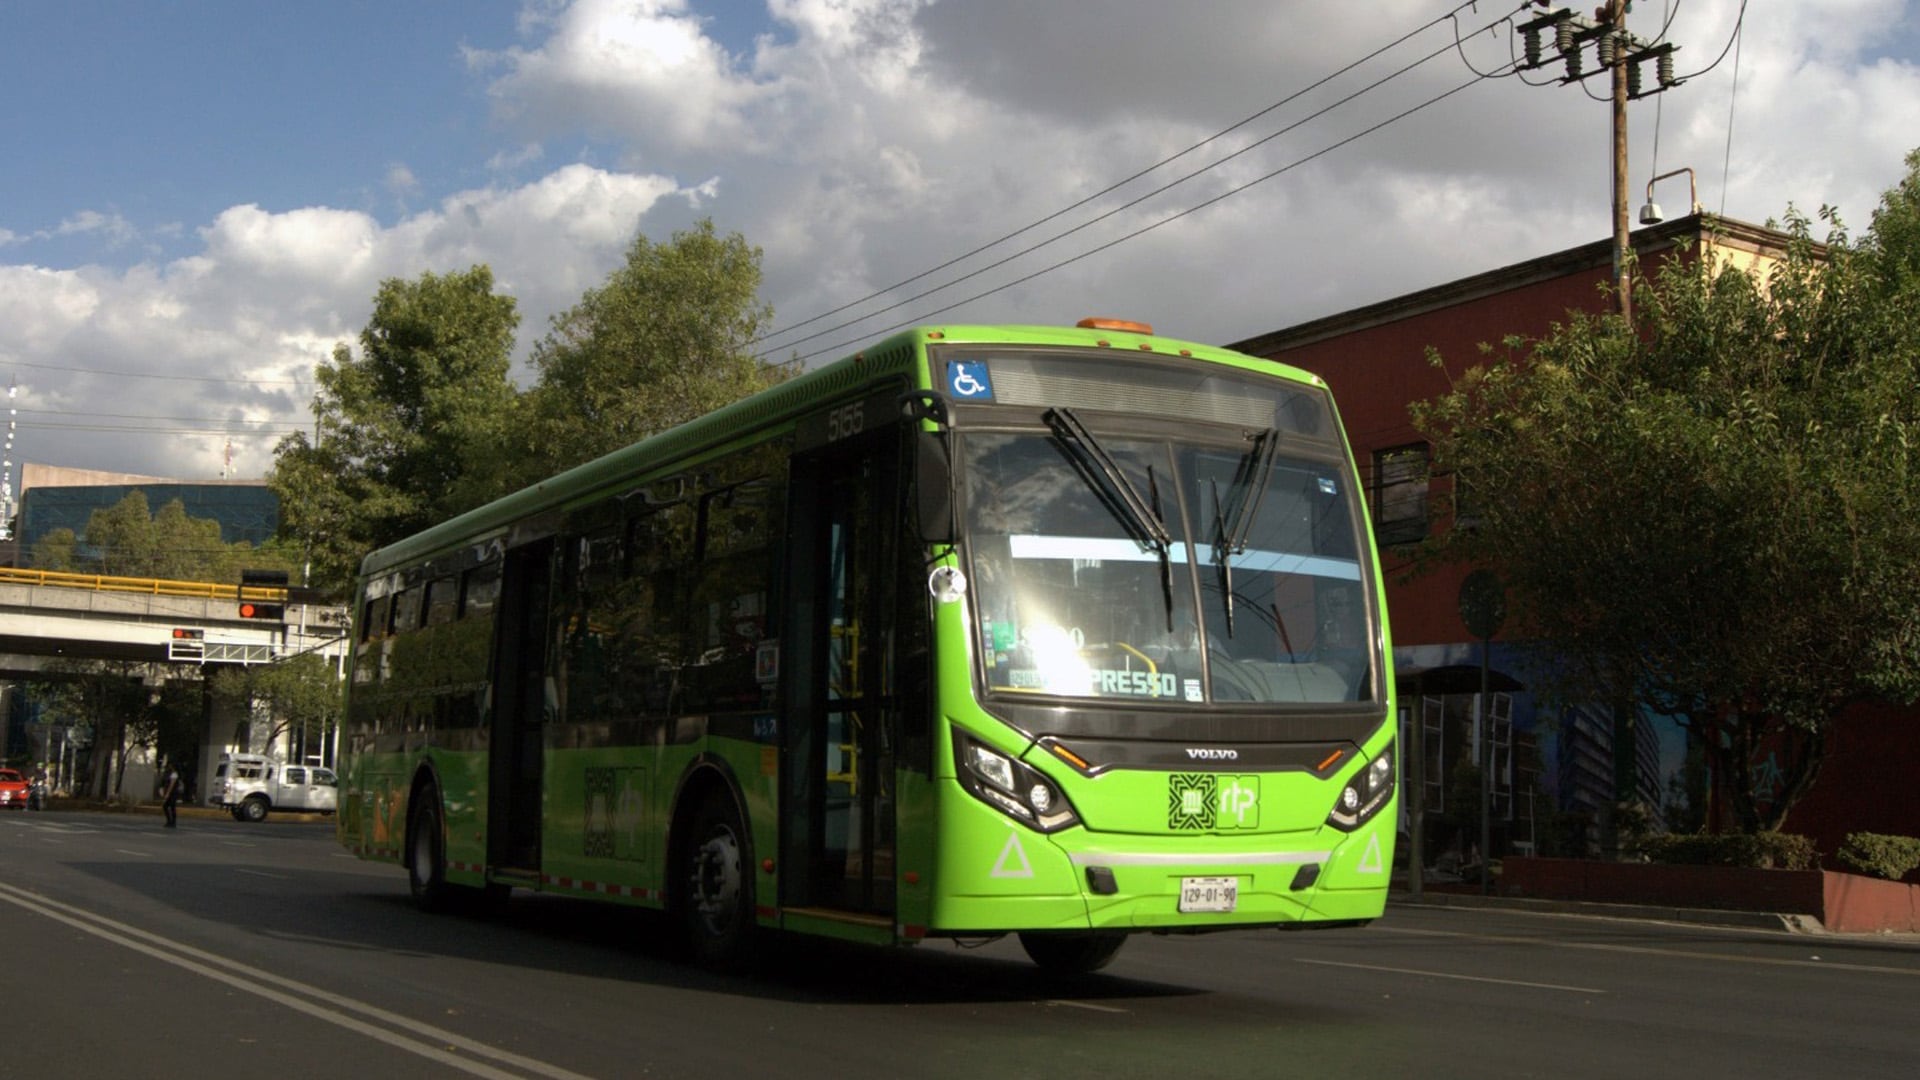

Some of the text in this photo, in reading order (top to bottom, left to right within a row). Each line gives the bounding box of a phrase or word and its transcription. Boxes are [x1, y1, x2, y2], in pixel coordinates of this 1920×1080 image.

[828, 401, 864, 441] 5155
[1089, 669, 1177, 697] PRESSO
[1186, 748, 1238, 760] VOLVO
[1221, 780, 1255, 822] rtp
[1184, 887, 1236, 903] 129-01-90
